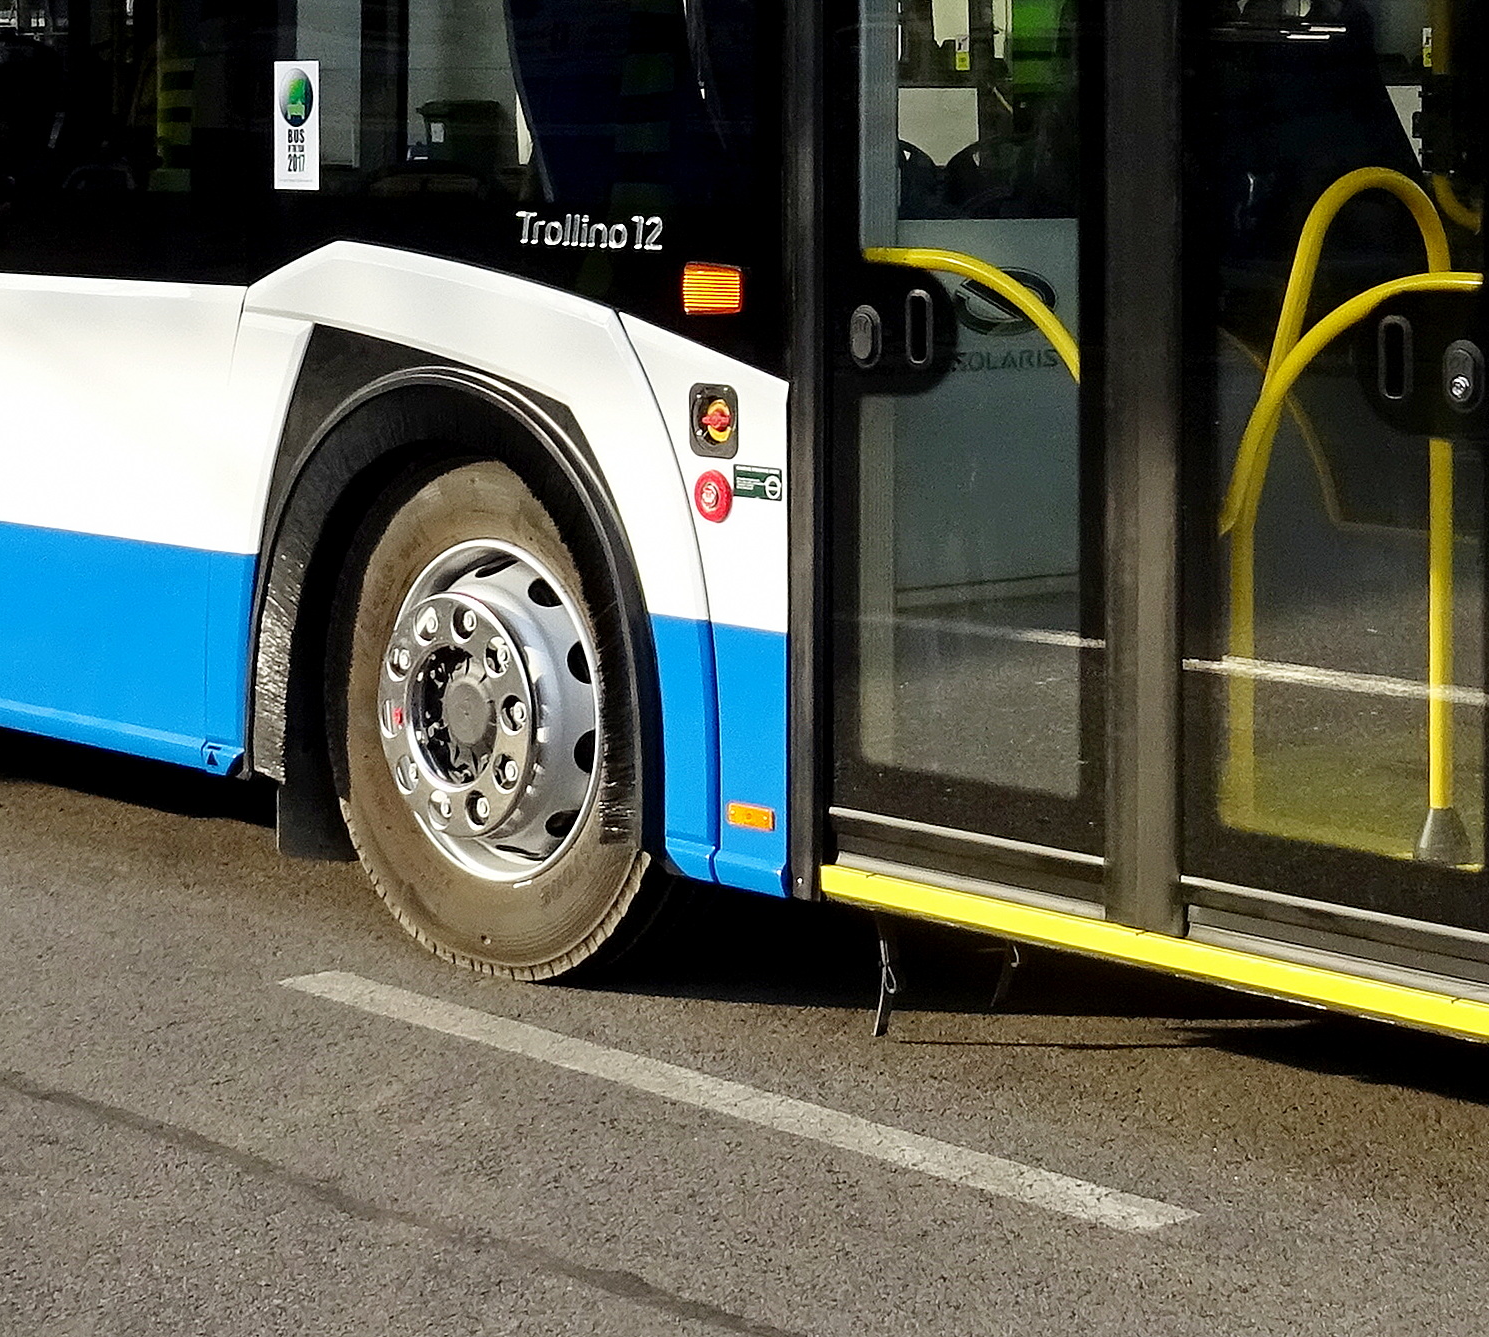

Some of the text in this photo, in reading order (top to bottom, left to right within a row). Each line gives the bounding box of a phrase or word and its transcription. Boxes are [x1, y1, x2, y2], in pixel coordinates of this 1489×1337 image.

[287, 128, 305, 144] BUS
[287, 154, 305, 172] 2017
[515, 210, 663, 251] Trollino 12
